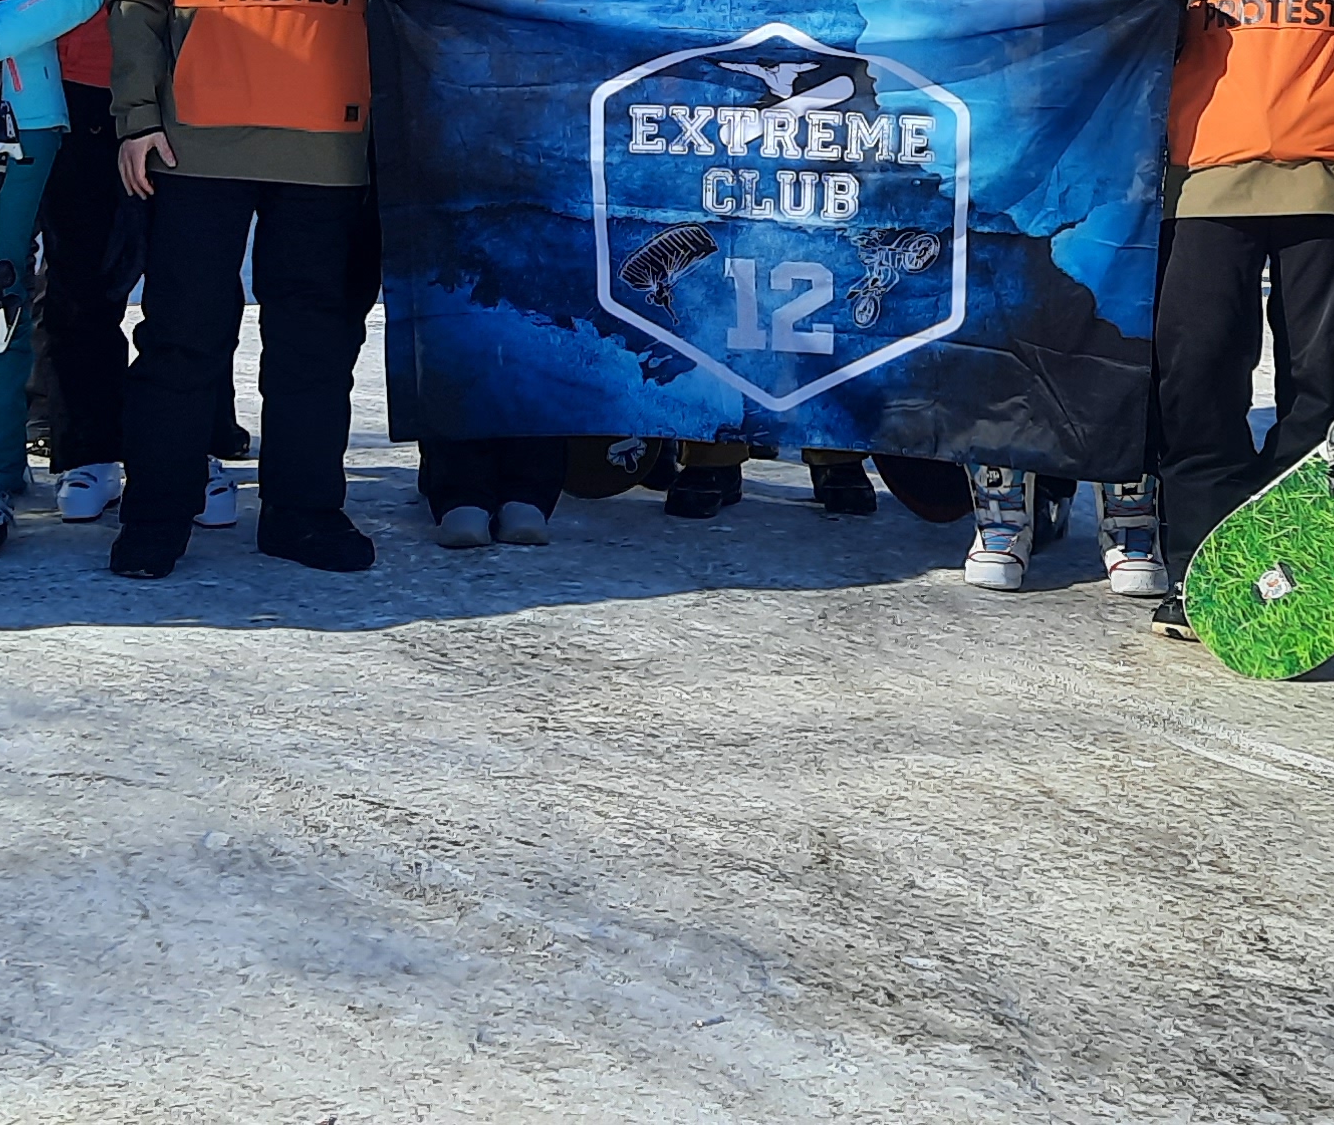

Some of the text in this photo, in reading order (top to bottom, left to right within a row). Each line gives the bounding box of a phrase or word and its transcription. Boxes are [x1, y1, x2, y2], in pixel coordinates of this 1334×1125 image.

[628, 104, 936, 165] EXTREME
[702, 167, 860, 221] CLUB
[724, 257, 835, 355] 12
